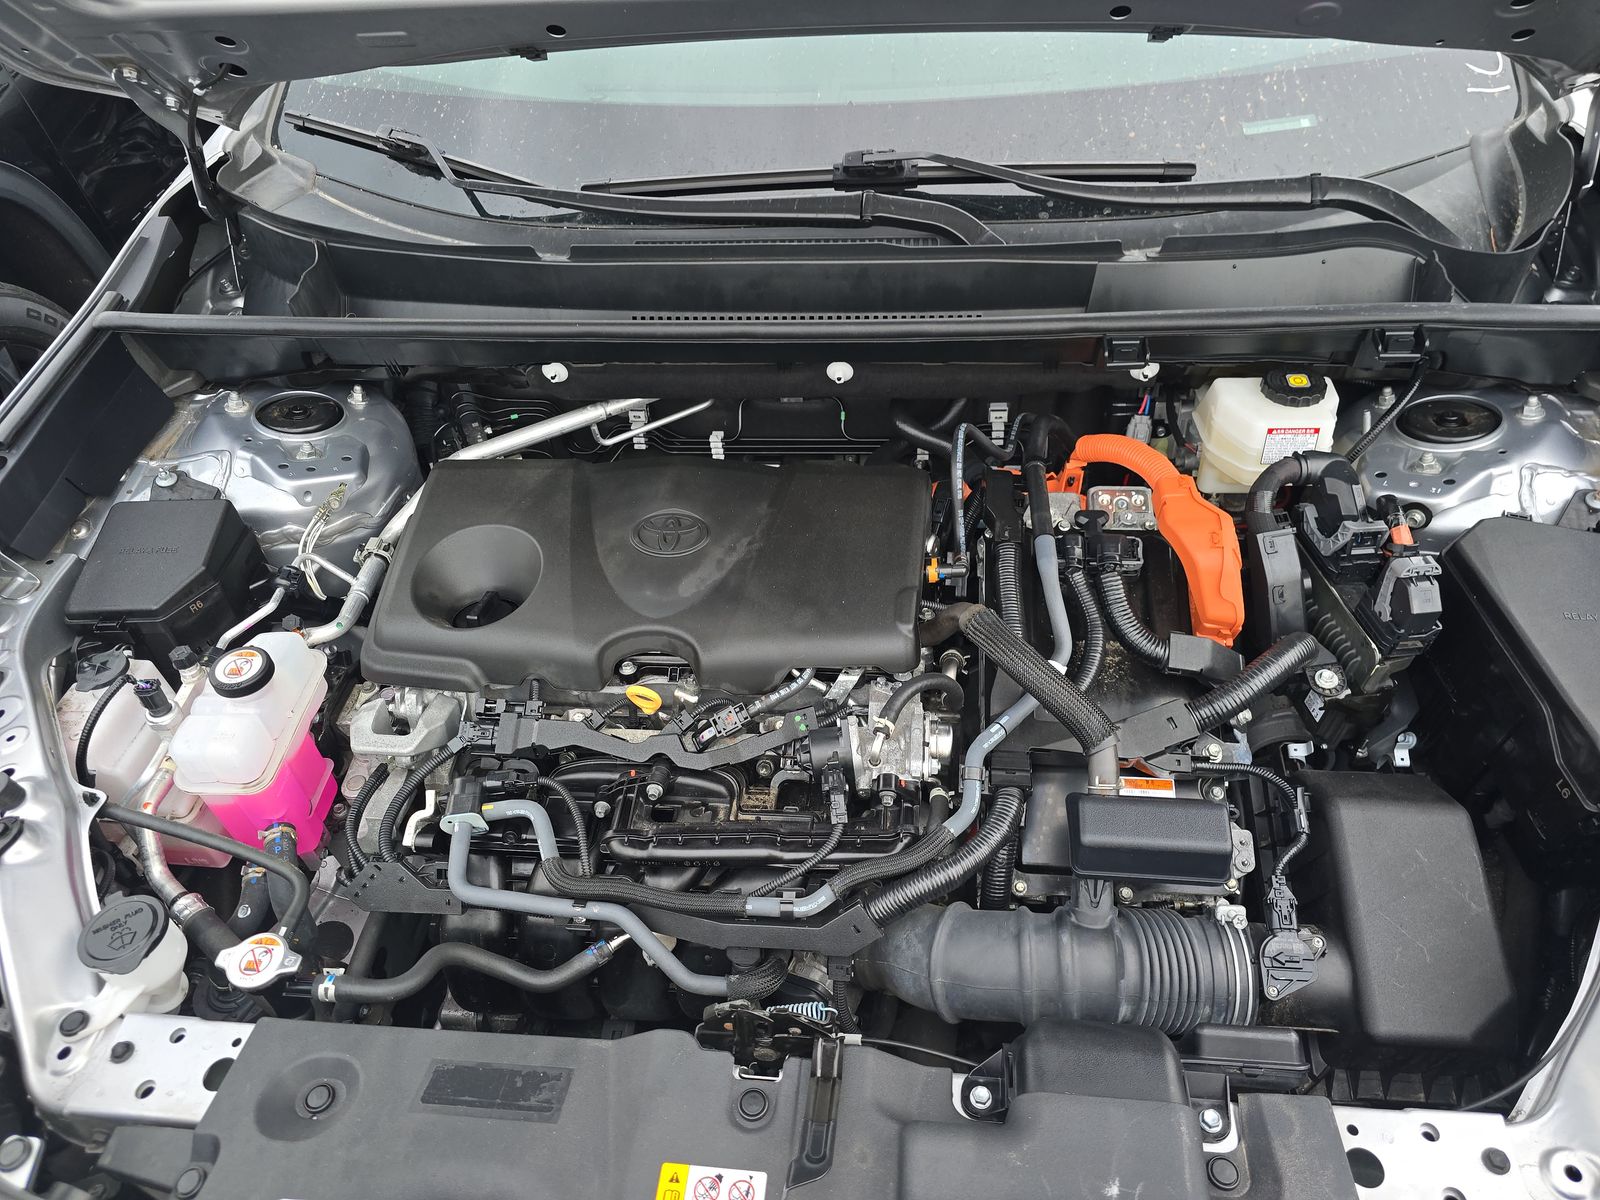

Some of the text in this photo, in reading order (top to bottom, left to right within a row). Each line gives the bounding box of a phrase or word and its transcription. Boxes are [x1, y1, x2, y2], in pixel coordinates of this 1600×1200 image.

[189, 600, 204, 613] R6
[1562, 611, 1598, 622] RELAY
[1555, 779, 1571, 799] L6
